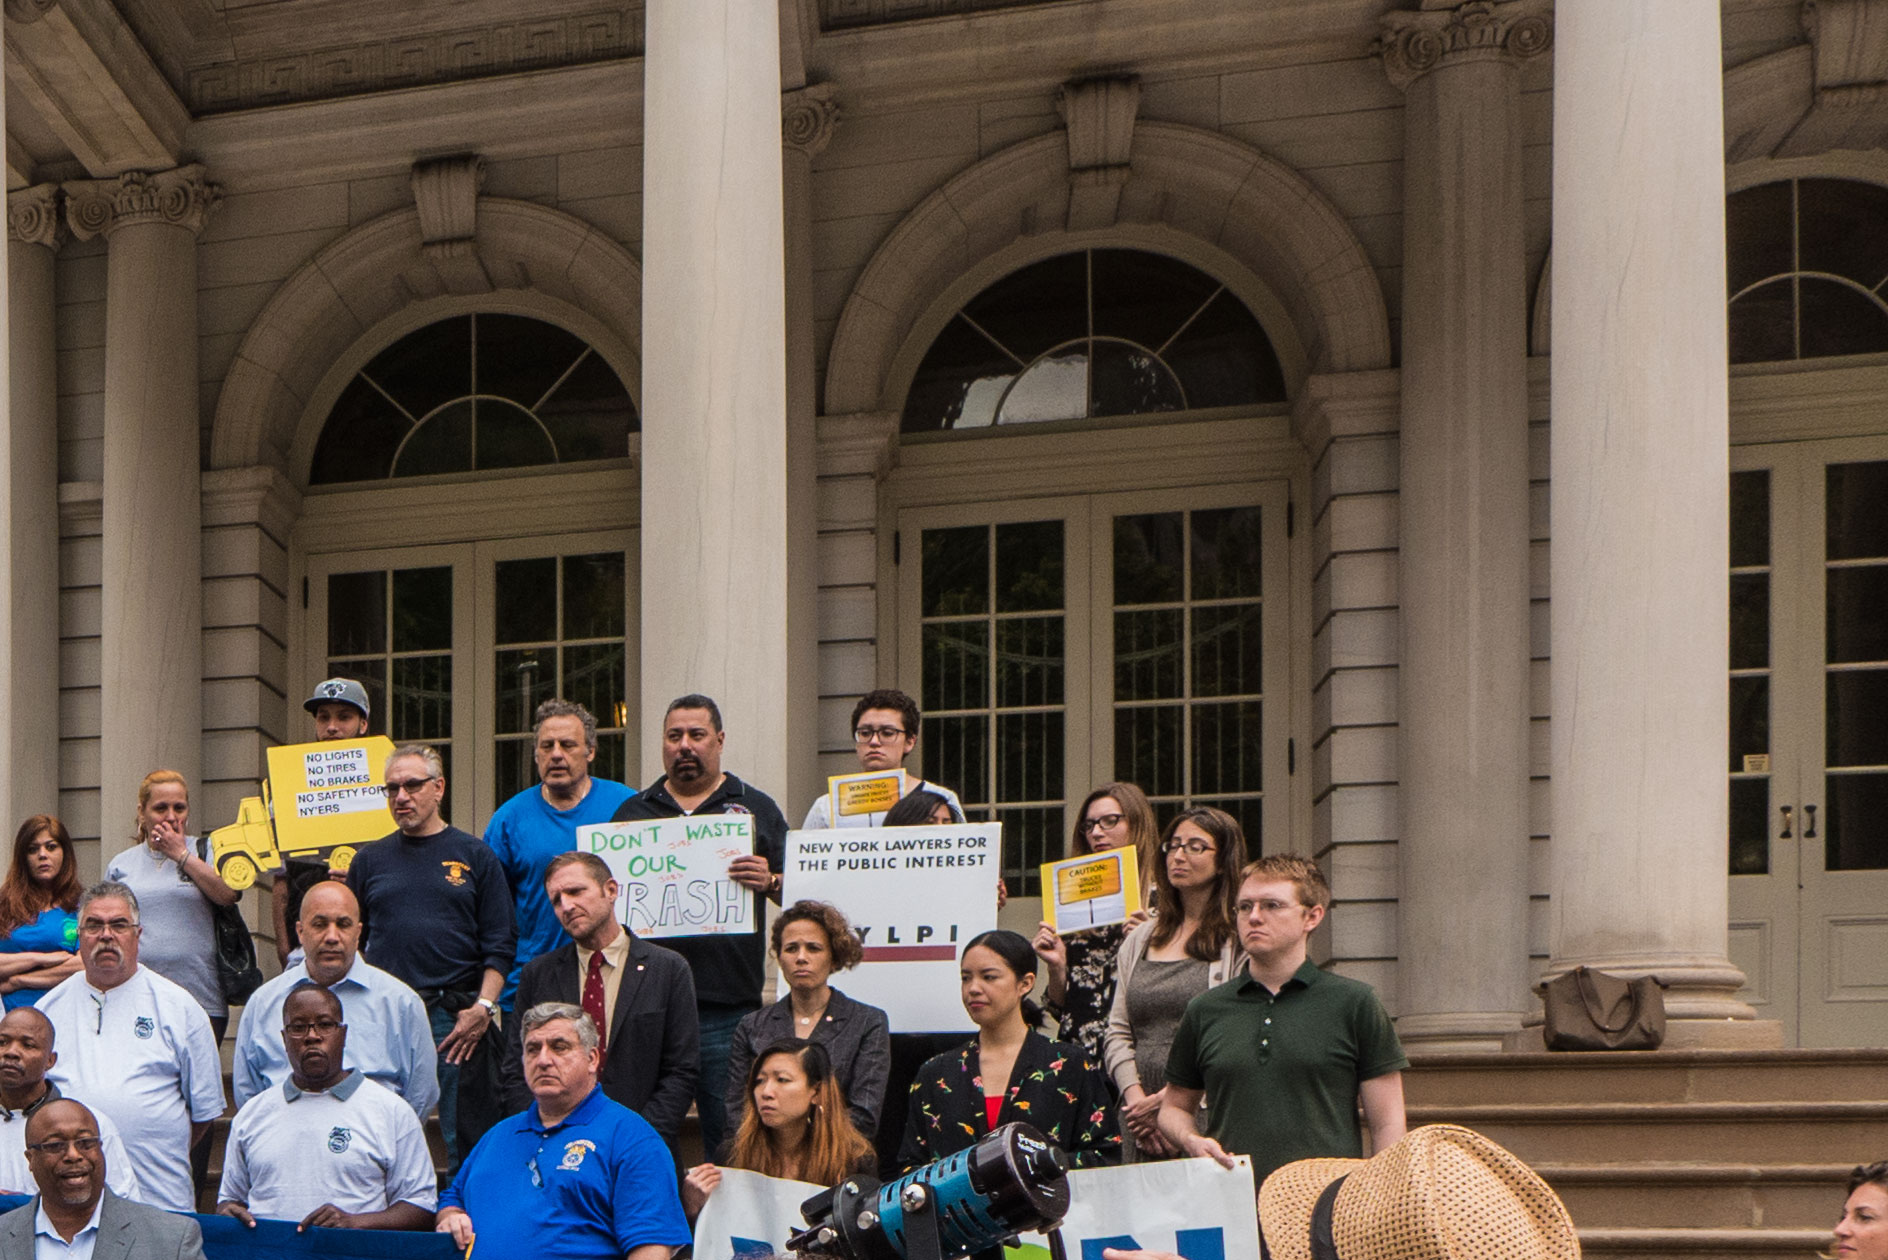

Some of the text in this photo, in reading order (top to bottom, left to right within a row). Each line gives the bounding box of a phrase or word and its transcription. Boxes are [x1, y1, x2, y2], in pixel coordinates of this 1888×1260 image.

[306, 750, 363, 763] NO LIGHTS
[308, 763, 357, 775] NO TIRES
[309, 774, 370, 788] NO BRAKES
[298, 794, 314, 803] NO
[317, 788, 359, 802] SAFETY
[300, 804, 340, 816] NY'ERS
[591, 822, 749, 853] DON'T WASTE
[799, 837, 987, 854] NEW YORK LAWYERS FOR
[628, 854, 687, 878] OUR
[799, 854, 986, 871] THE PUBLIC INTEREST
[1069, 864, 1108, 878] CAUTION:
